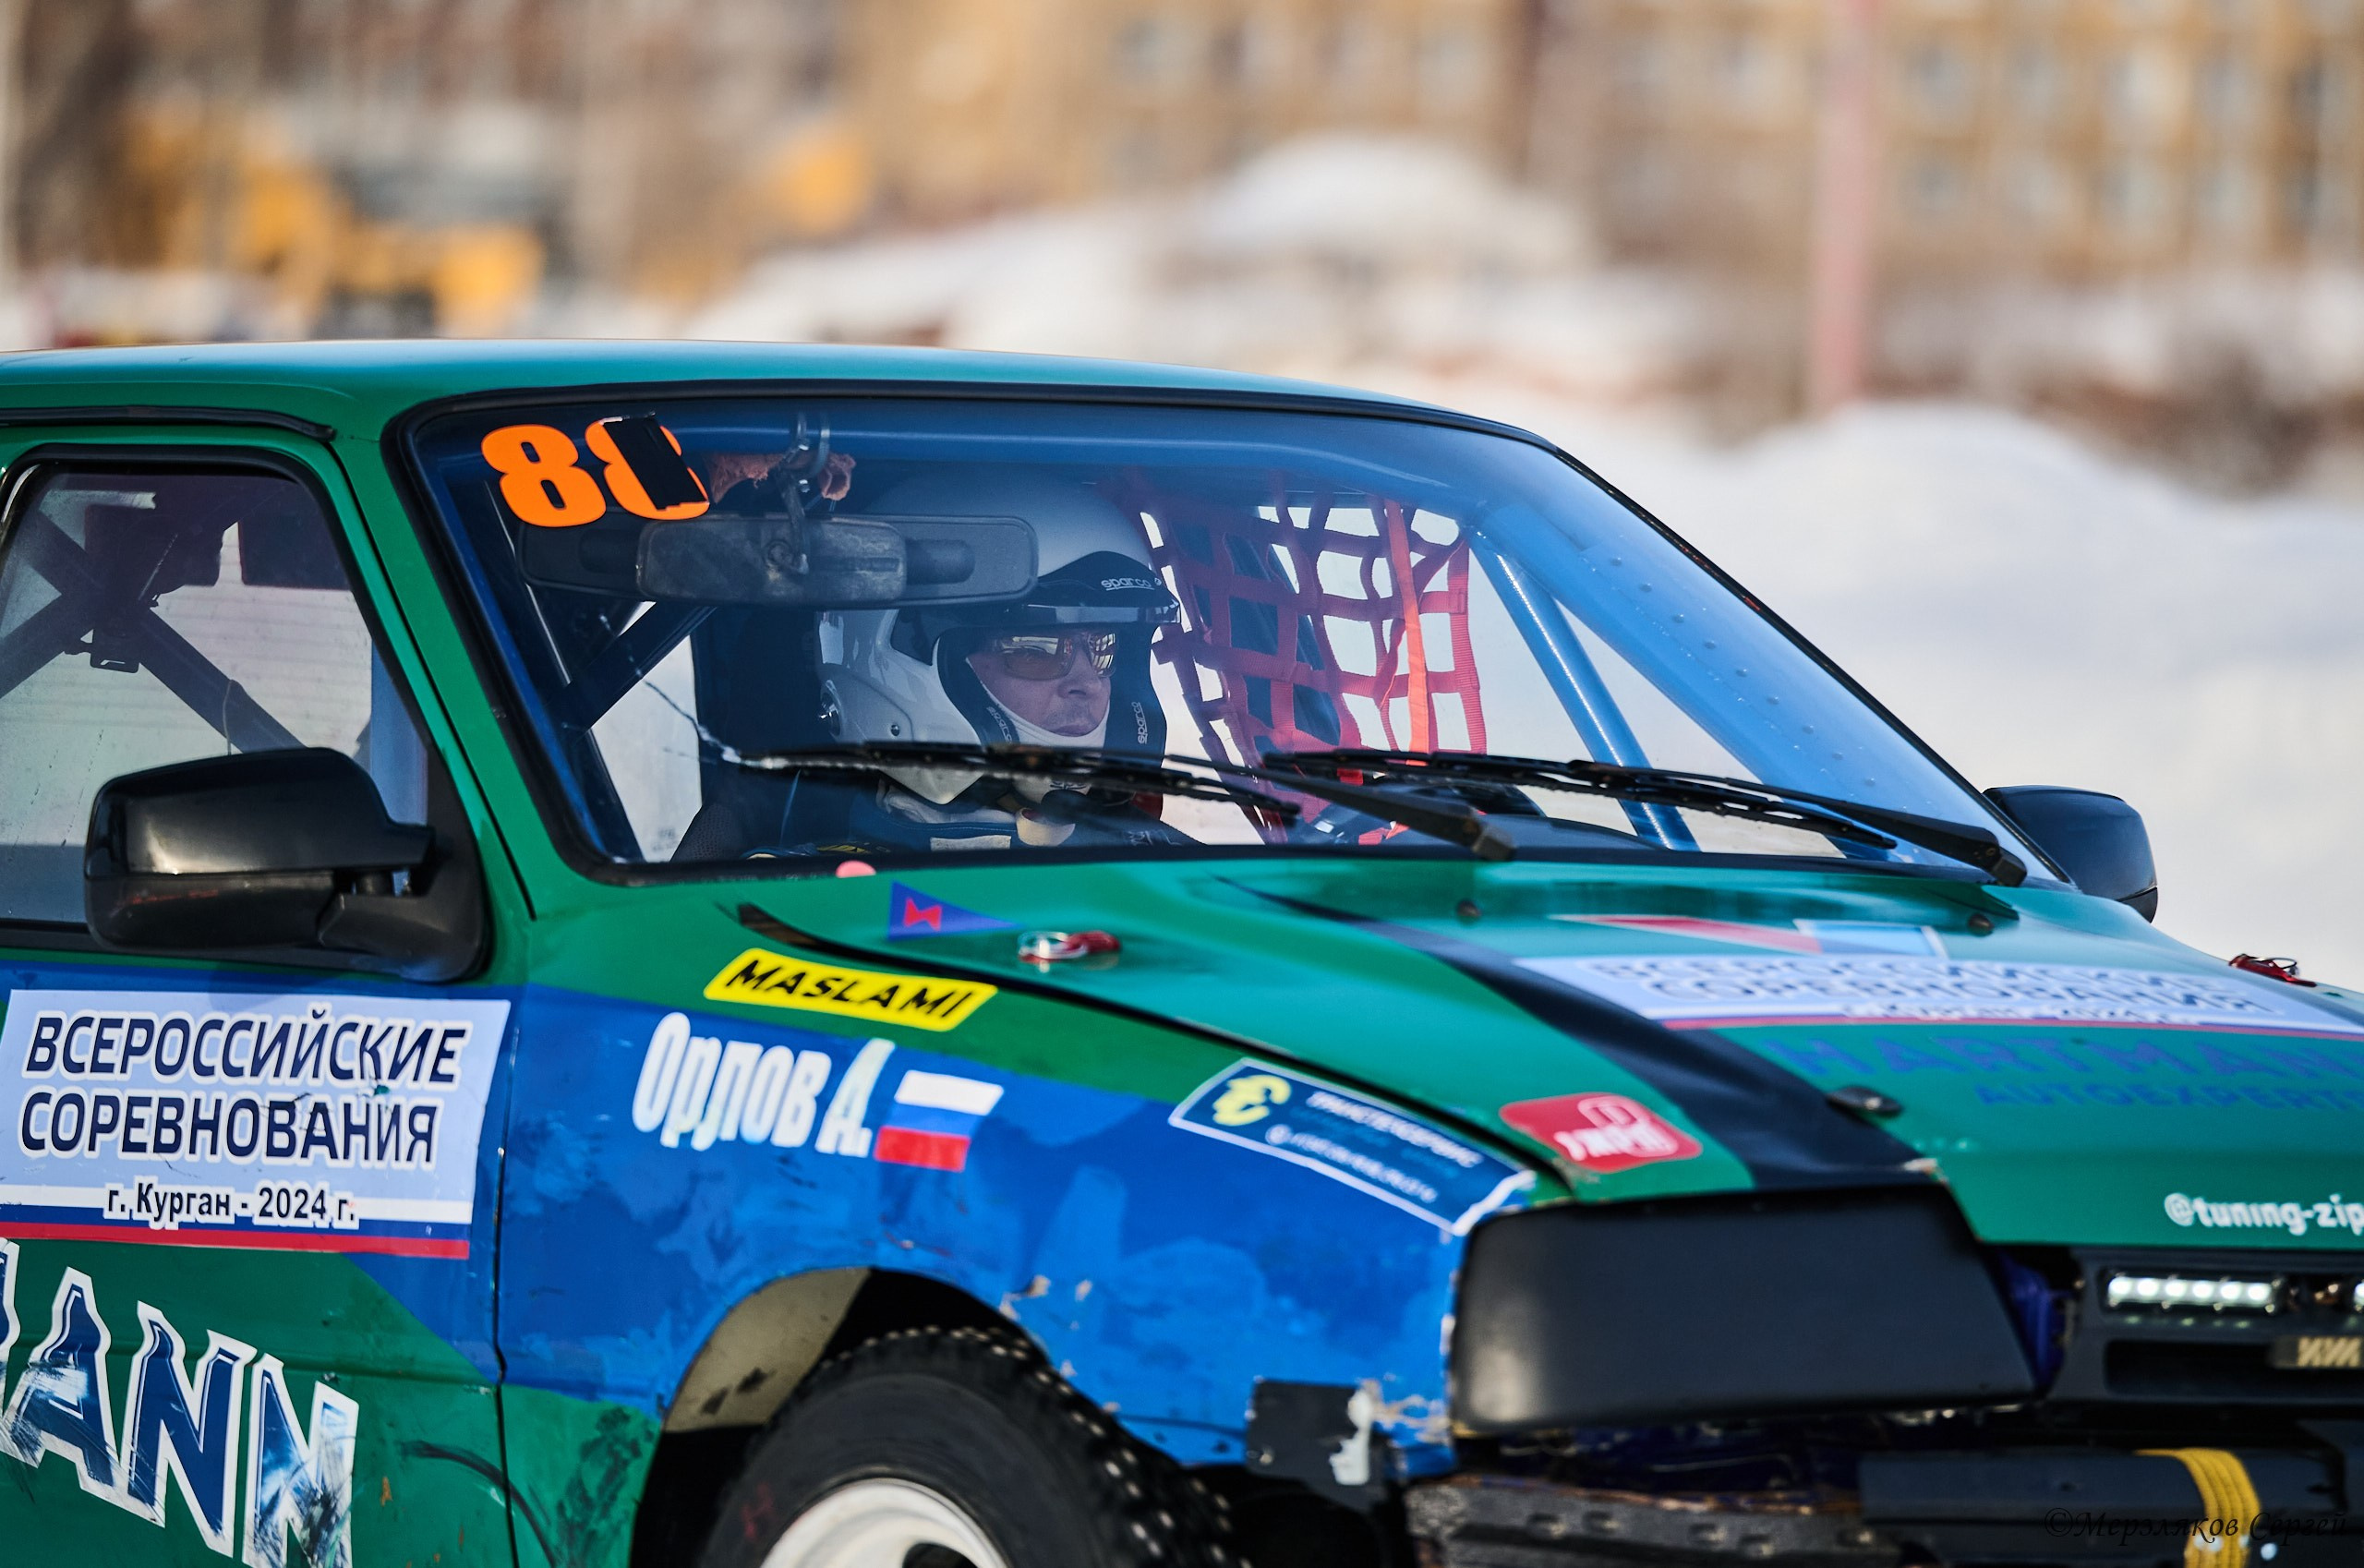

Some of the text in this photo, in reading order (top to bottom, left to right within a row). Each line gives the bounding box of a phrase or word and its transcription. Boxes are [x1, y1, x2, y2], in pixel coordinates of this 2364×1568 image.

[1101, 577, 1153, 590] sparco
[1131, 702, 1148, 744] sparco
[726, 959, 973, 1018] MASLAMI
[26, 1008, 466, 1084] ВСЕРОССИЙСКИЕ
[20, 1092, 438, 1164] СОРЕВНОВАНИЯ
[107, 1189, 126, 1212] г.
[138, 1182, 231, 1223] Курган
[259, 1187, 326, 1220] 2024
[338, 1199, 355, 1221] г.
[0, 1237, 358, 1568] ANN
